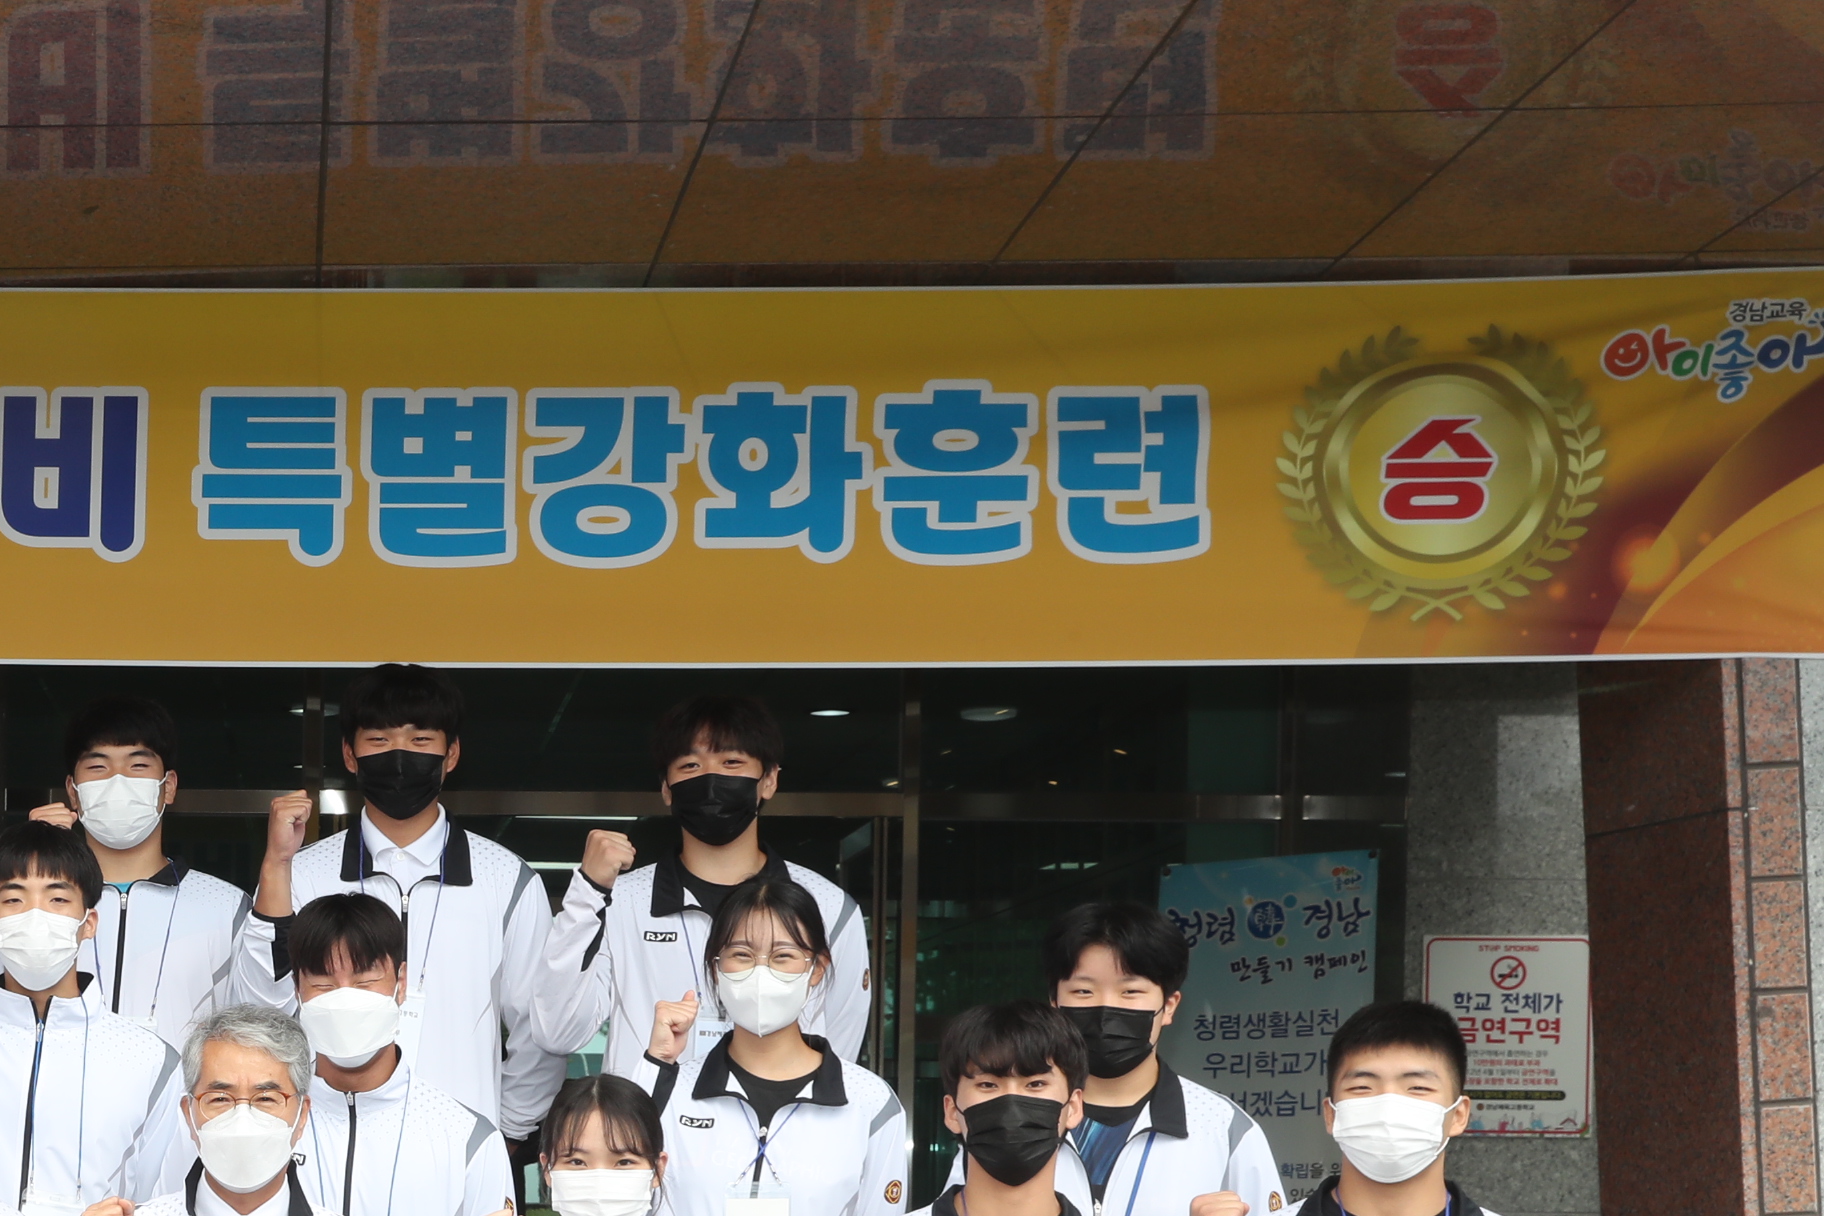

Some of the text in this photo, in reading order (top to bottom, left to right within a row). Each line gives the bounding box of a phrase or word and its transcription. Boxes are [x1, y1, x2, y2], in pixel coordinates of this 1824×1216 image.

[1730, 301, 1806, 323] 경남교육
[1604, 328, 1824, 399] 아이좋아
[203, 390, 1200, 557] 특별강화훈련
[1386, 422, 1490, 519] 승
[1304, 896, 1371, 939] 경남
[646, 932, 676, 941] RYN
[1230, 949, 1368, 985] 만들기 캠페인
[1453, 993, 1563, 1013] 학교 전체가
[1193, 1008, 1340, 1041] 청렴생활실천
[1458, 1017, 1561, 1044] 금연구역
[681, 1117, 713, 1127] RYN
